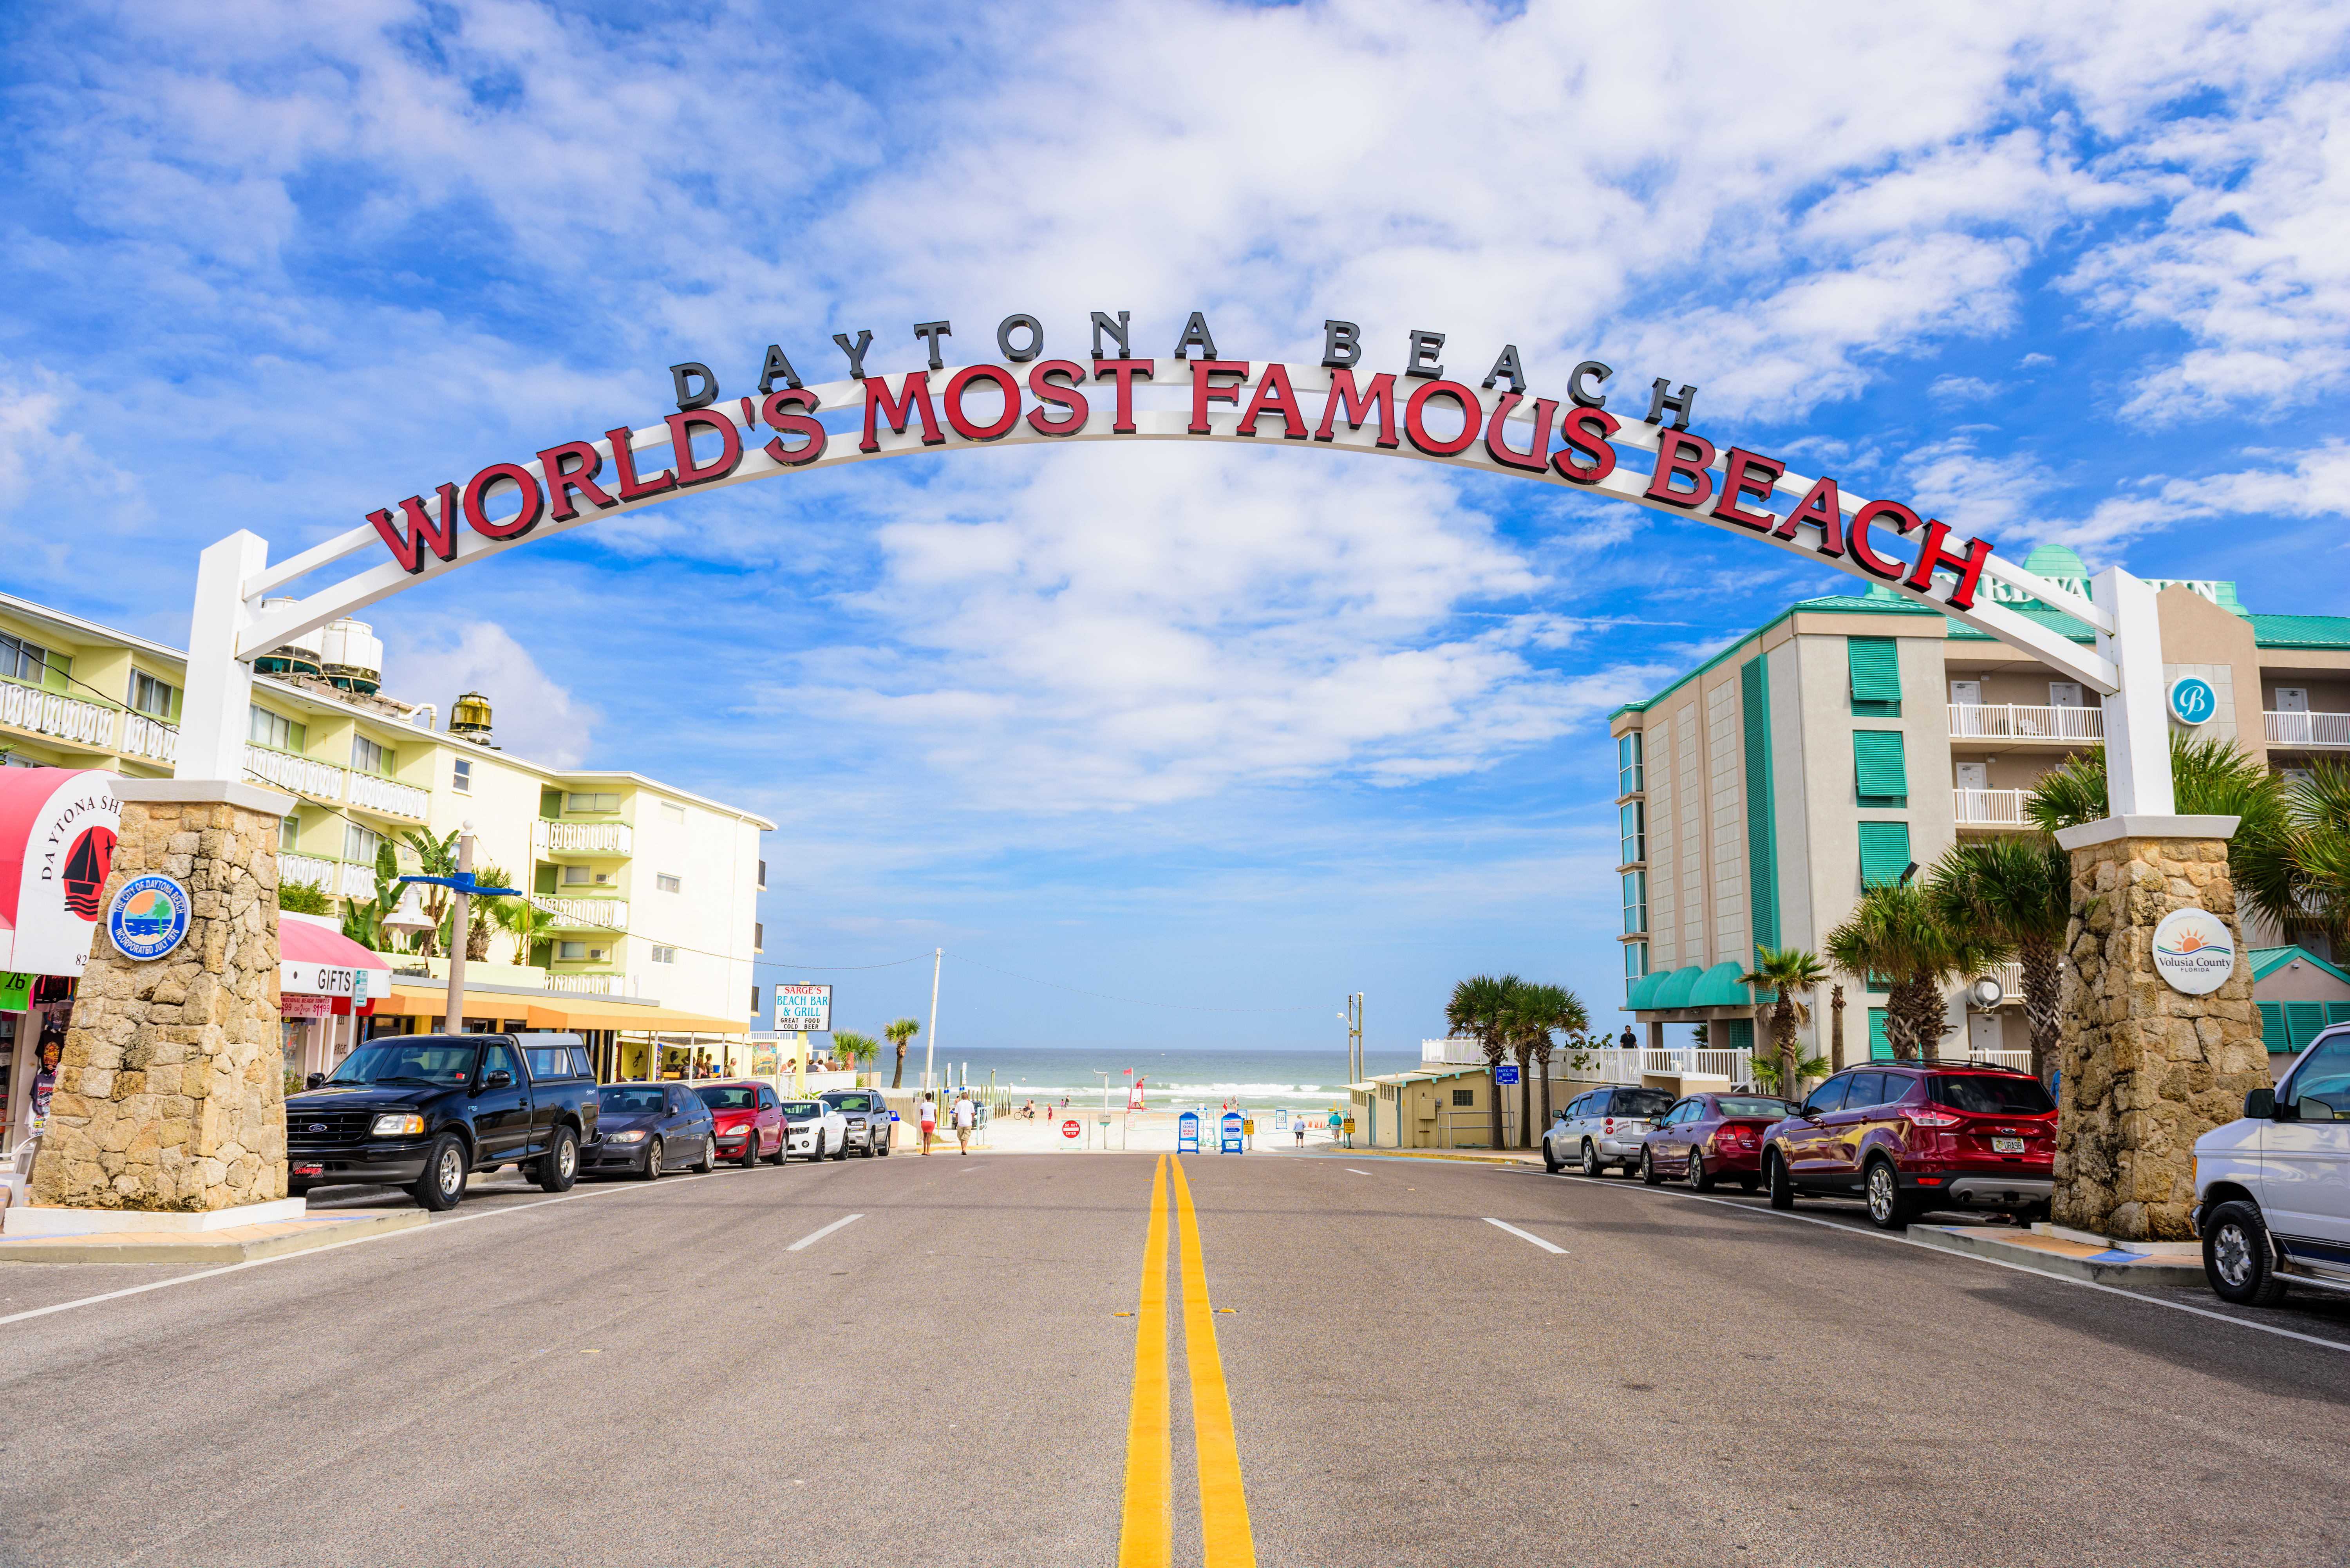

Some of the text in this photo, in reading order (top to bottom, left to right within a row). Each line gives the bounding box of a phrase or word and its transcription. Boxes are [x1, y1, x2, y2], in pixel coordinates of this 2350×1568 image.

[669, 311, 1697, 432] DAYTONA BEACH
[365, 359, 1994, 611] WORLD'S MOST FAMOUS BEACH
[42, 796, 121, 881] DAYTONA SH
[114, 880, 185, 914] THE CITY OF DAYTONA BEACH
[114, 928, 180, 954] INCORPORATED JULY 1876
[2158, 957, 2232, 970] Volusia County
[318, 968, 351, 992] GIFTS
[777, 996, 828, 1005] BEACH BAR
[783, 1007, 821, 1016] & GRILL
[2004, 1141, 2022, 1150] URA9B
